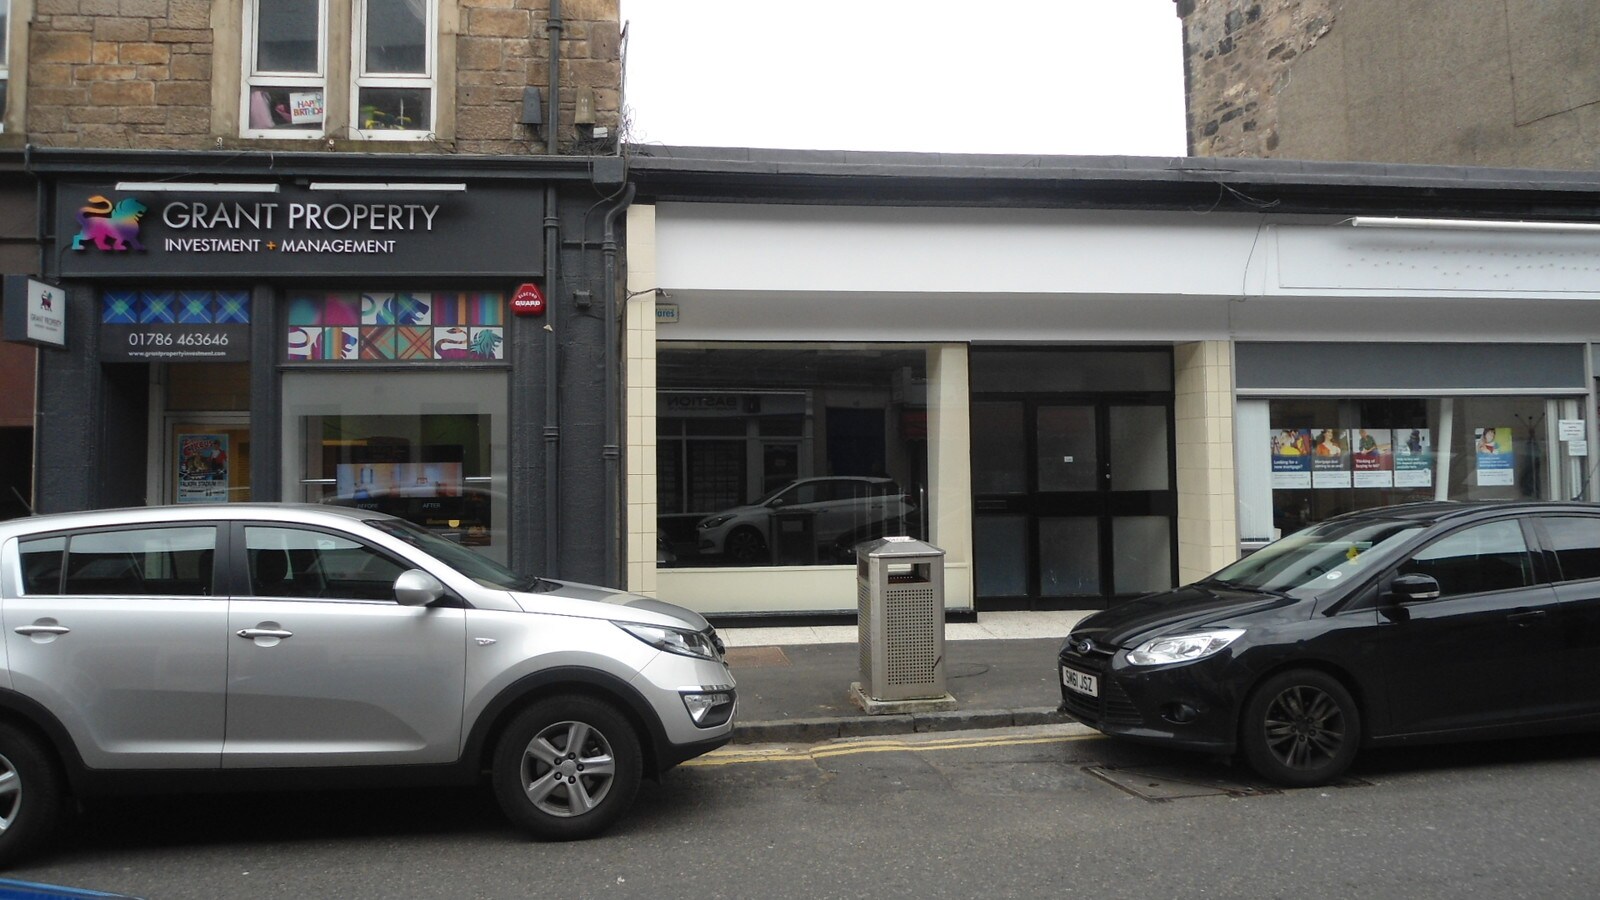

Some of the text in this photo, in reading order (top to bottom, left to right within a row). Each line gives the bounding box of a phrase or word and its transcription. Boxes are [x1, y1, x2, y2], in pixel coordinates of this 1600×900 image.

[293, 107, 323, 116] BIRTHDA
[163, 201, 439, 231] GRANT PROPERTY
[165, 238, 261, 252] INVESTMENT
[281, 240, 396, 253] MANAGEMENT
[518, 291, 538, 299] ELECTRO
[128, 333, 229, 346] 01786 463646
[128, 350, 226, 358] www.grantpropertyinvestment.com
[1065, 669, 1093, 692] SM61 JSZ
